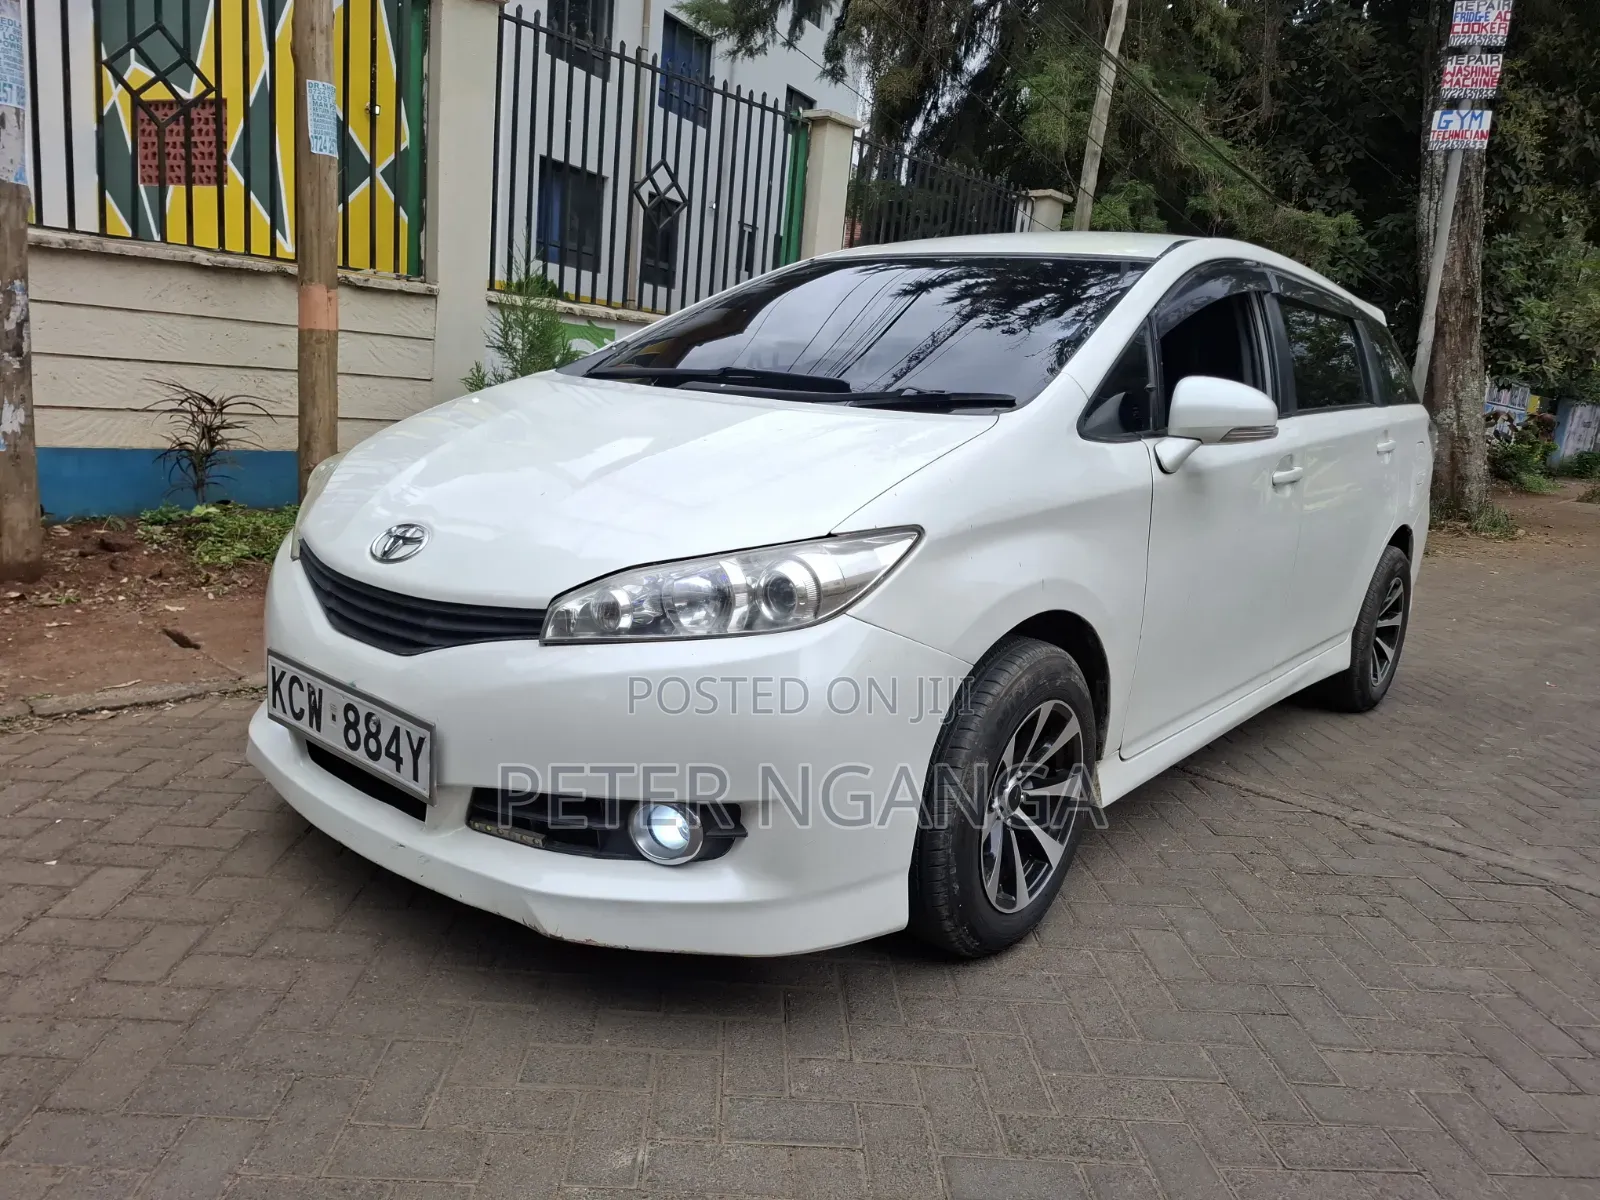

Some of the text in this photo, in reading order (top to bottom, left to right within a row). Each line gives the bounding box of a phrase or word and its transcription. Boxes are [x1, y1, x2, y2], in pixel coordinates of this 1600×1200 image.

[1455, 1, 1511, 11] REPAIR
[1453, 10, 1512, 22] FRIDGE AC
[1451, 22, 1508, 34] COOKER
[1449, 34, 1506, 46] 0722639833
[1446, 55, 1501, 65] REPAIR
[1442, 65, 1503, 77] WASHING
[1441, 77, 1501, 88] MACHINE
[1440, 88, 1496, 99] 0722639833
[312, 101, 328, 109] MAN
[1437, 110, 1485, 130] GYM
[1432, 130, 1490, 141] TECHNICIAN
[1428, 140, 1486, 151] 0722639833
[271, 665, 427, 783] KCW 884Y
